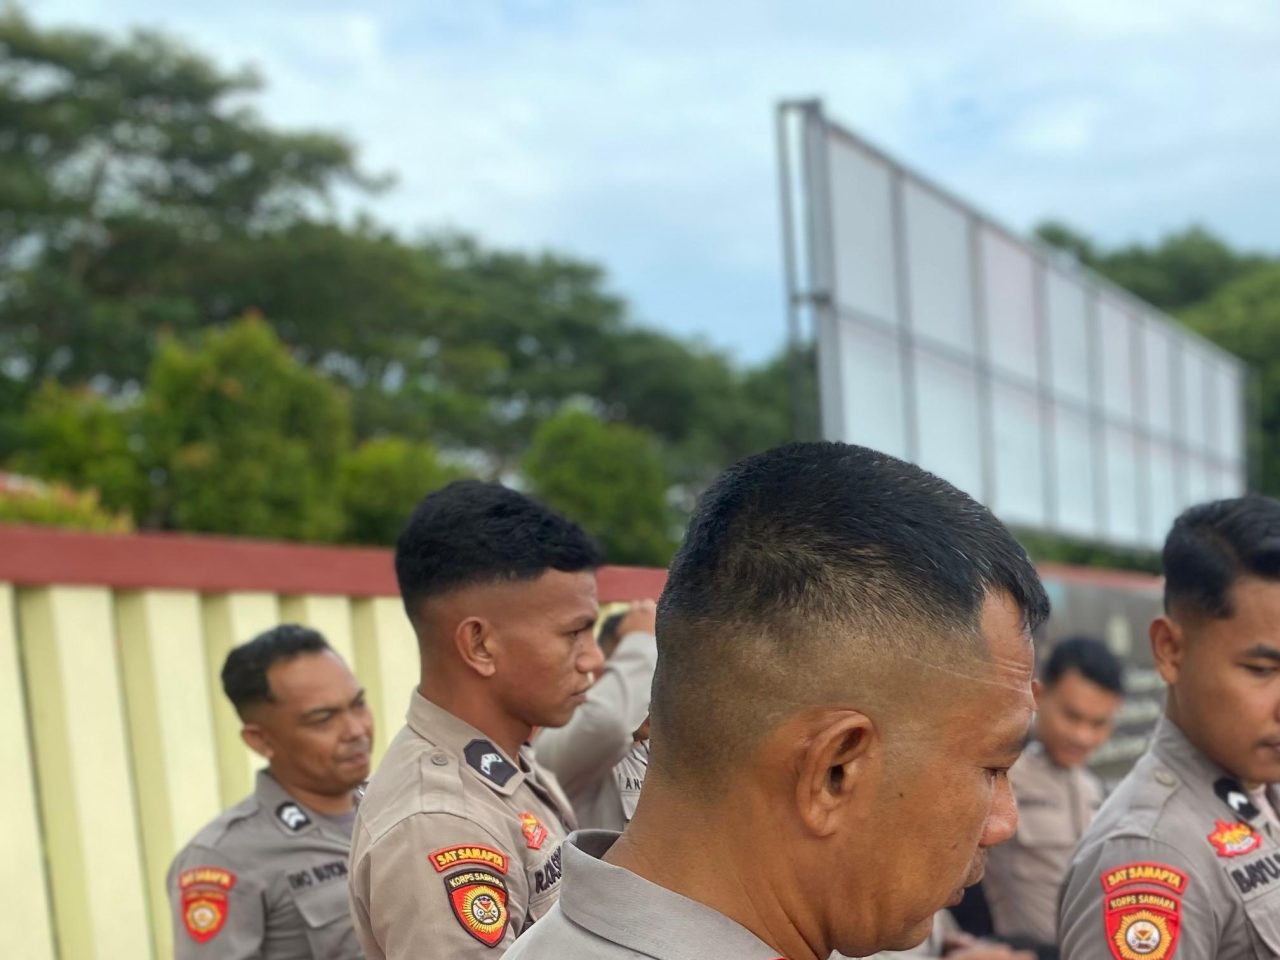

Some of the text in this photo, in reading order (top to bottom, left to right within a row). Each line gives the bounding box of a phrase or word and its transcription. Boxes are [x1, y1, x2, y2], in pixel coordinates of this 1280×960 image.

[436, 851, 457, 865] SAT
[449, 873, 474, 888] KORPS
[1107, 866, 1181, 888] SAT SAMAPTA
[1110, 895, 1137, 909] KORPS
